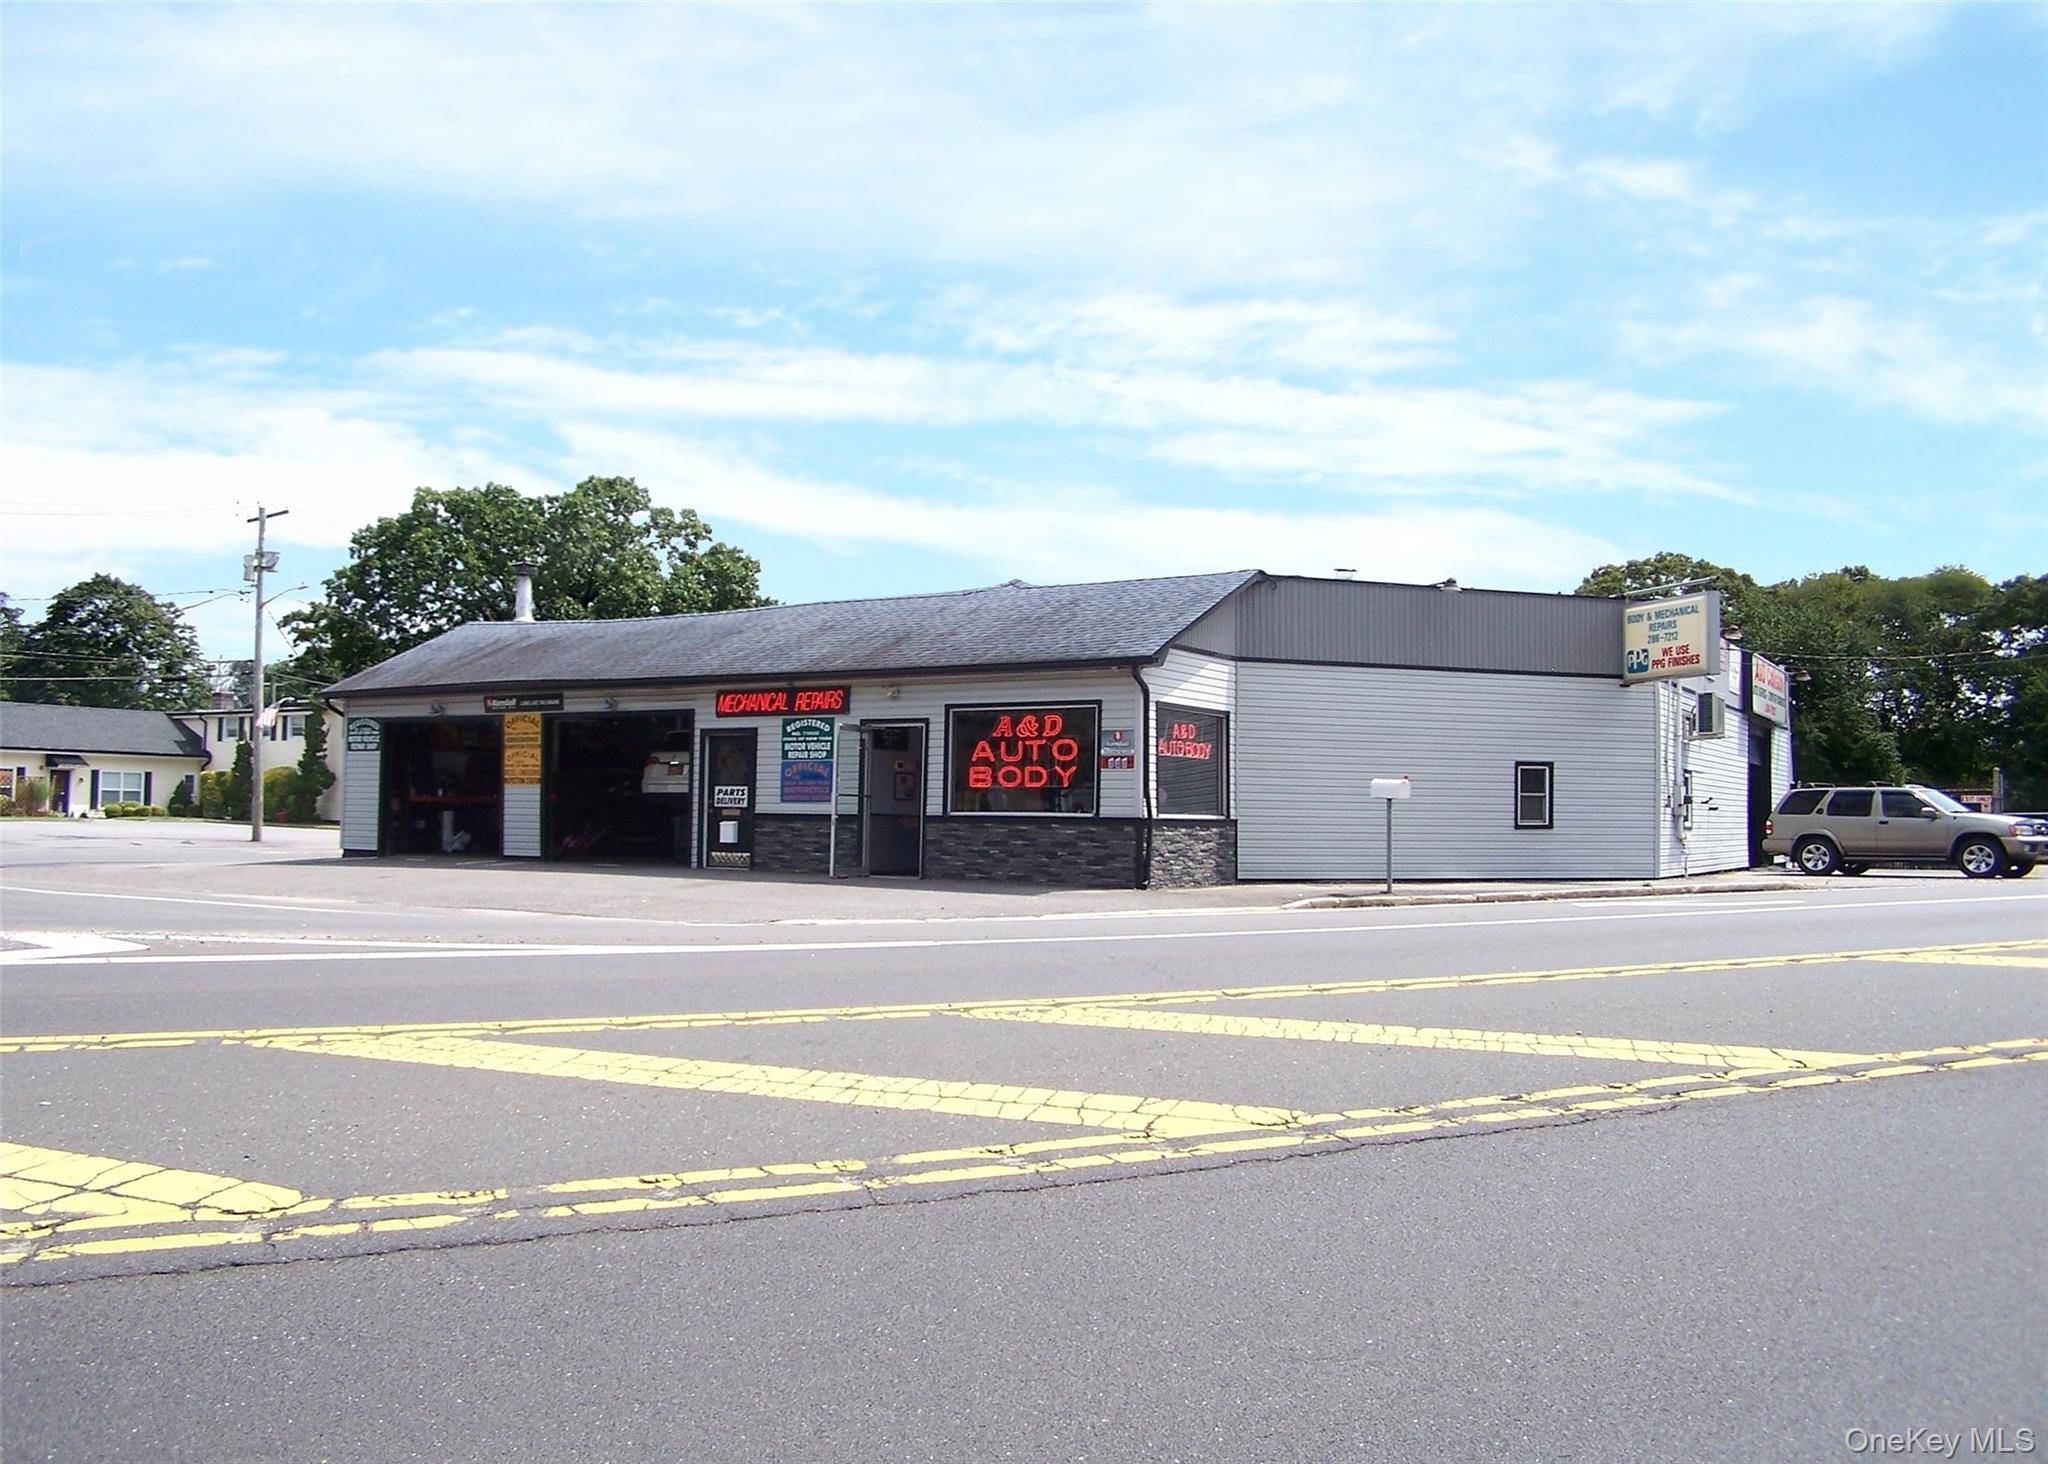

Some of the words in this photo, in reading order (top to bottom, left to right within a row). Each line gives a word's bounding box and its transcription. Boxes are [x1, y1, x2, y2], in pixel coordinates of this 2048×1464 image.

[1627, 614, 1644, 624] BODY
[1654, 605, 1699, 620] MECHANICAL
[1648, 620, 1677, 632] REPAIRS
[1662, 647, 1673, 657] WE
[1676, 644, 1690, 655] USE
[1628, 650, 1648, 670] PPG
[1651, 659, 1666, 669] PPG
[1668, 655, 1700, 667] FINISHES
[717, 692, 788, 713] MECHANICAL
[794, 690, 844, 712] REPAIRS
[785, 719, 831, 733] REGISTERED
[992, 714, 1063, 738] A&D
[1173, 723, 1196, 740] A&D
[784, 743, 806, 751] MOTOR
[807, 742, 831, 751] VEHICLE
[971, 738, 1078, 762] AUTO
[1158, 738, 1184, 757] AUTO
[1185, 741, 1212, 760] BODY
[788, 751, 808, 759] REPAIR
[809, 751, 827, 759] SHOP
[969, 765, 1077, 788] BODY
[716, 788, 746, 797] PARTS
[716, 797, 746, 805] DELIVERY
